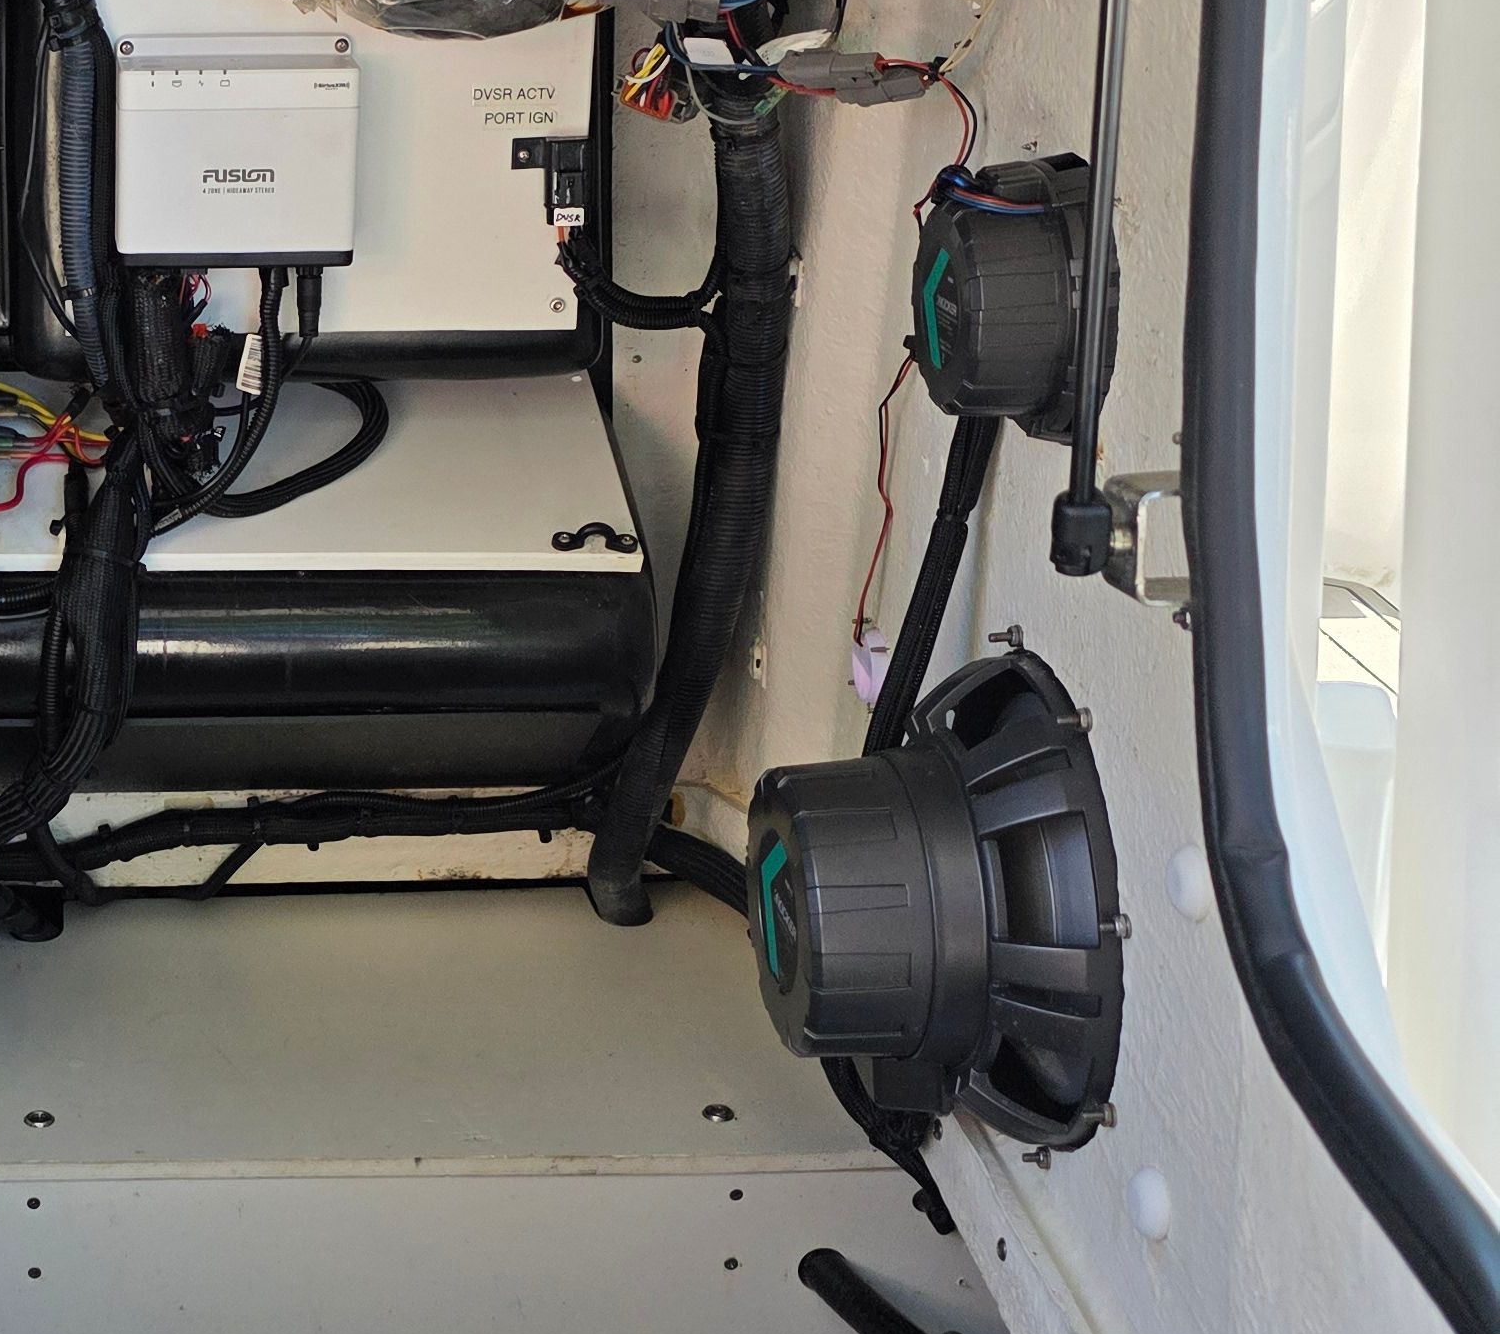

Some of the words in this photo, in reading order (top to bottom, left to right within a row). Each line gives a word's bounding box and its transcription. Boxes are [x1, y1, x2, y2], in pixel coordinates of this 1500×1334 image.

[473, 88, 512, 101] DVSR
[516, 87, 556, 100] ACTV
[484, 112, 524, 125] PORT
[528, 112, 554, 124] IGN
[202, 168, 275, 183] FUSION
[555, 213, 581, 223] DVSR
